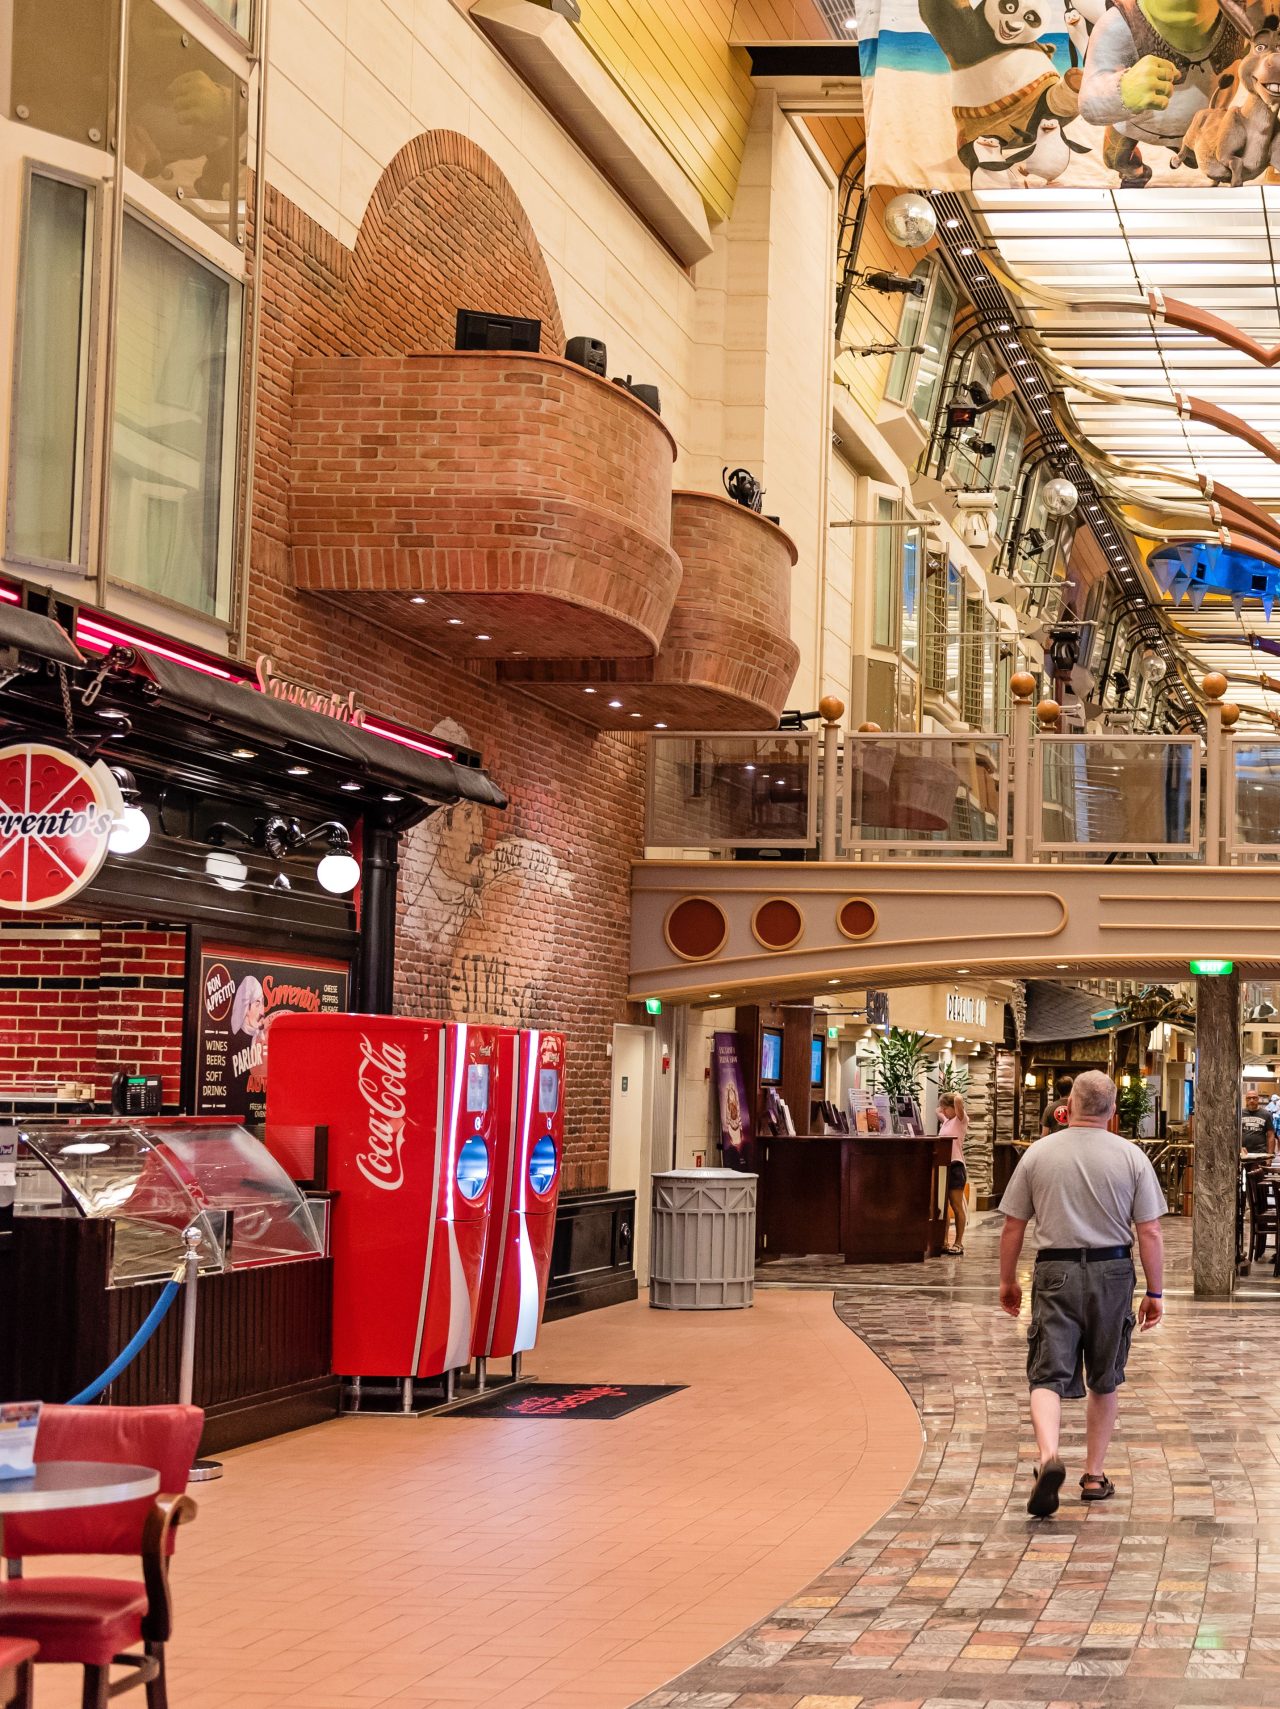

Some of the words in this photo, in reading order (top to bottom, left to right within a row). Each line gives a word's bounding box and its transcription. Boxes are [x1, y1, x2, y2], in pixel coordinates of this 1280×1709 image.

[207, 974, 221, 995] BON
[323, 984, 338, 993] CHEESE
[206, 980, 235, 1013] APPETITO
[263, 975, 320, 1013] Sorrento's
[321, 994, 339, 1004] PEPPERS
[205, 1040, 228, 1052] WINES
[206, 1055, 226, 1066] BEERS
[205, 1071, 222, 1082] SOFT
[203, 1085, 227, 1096] DRINKS
